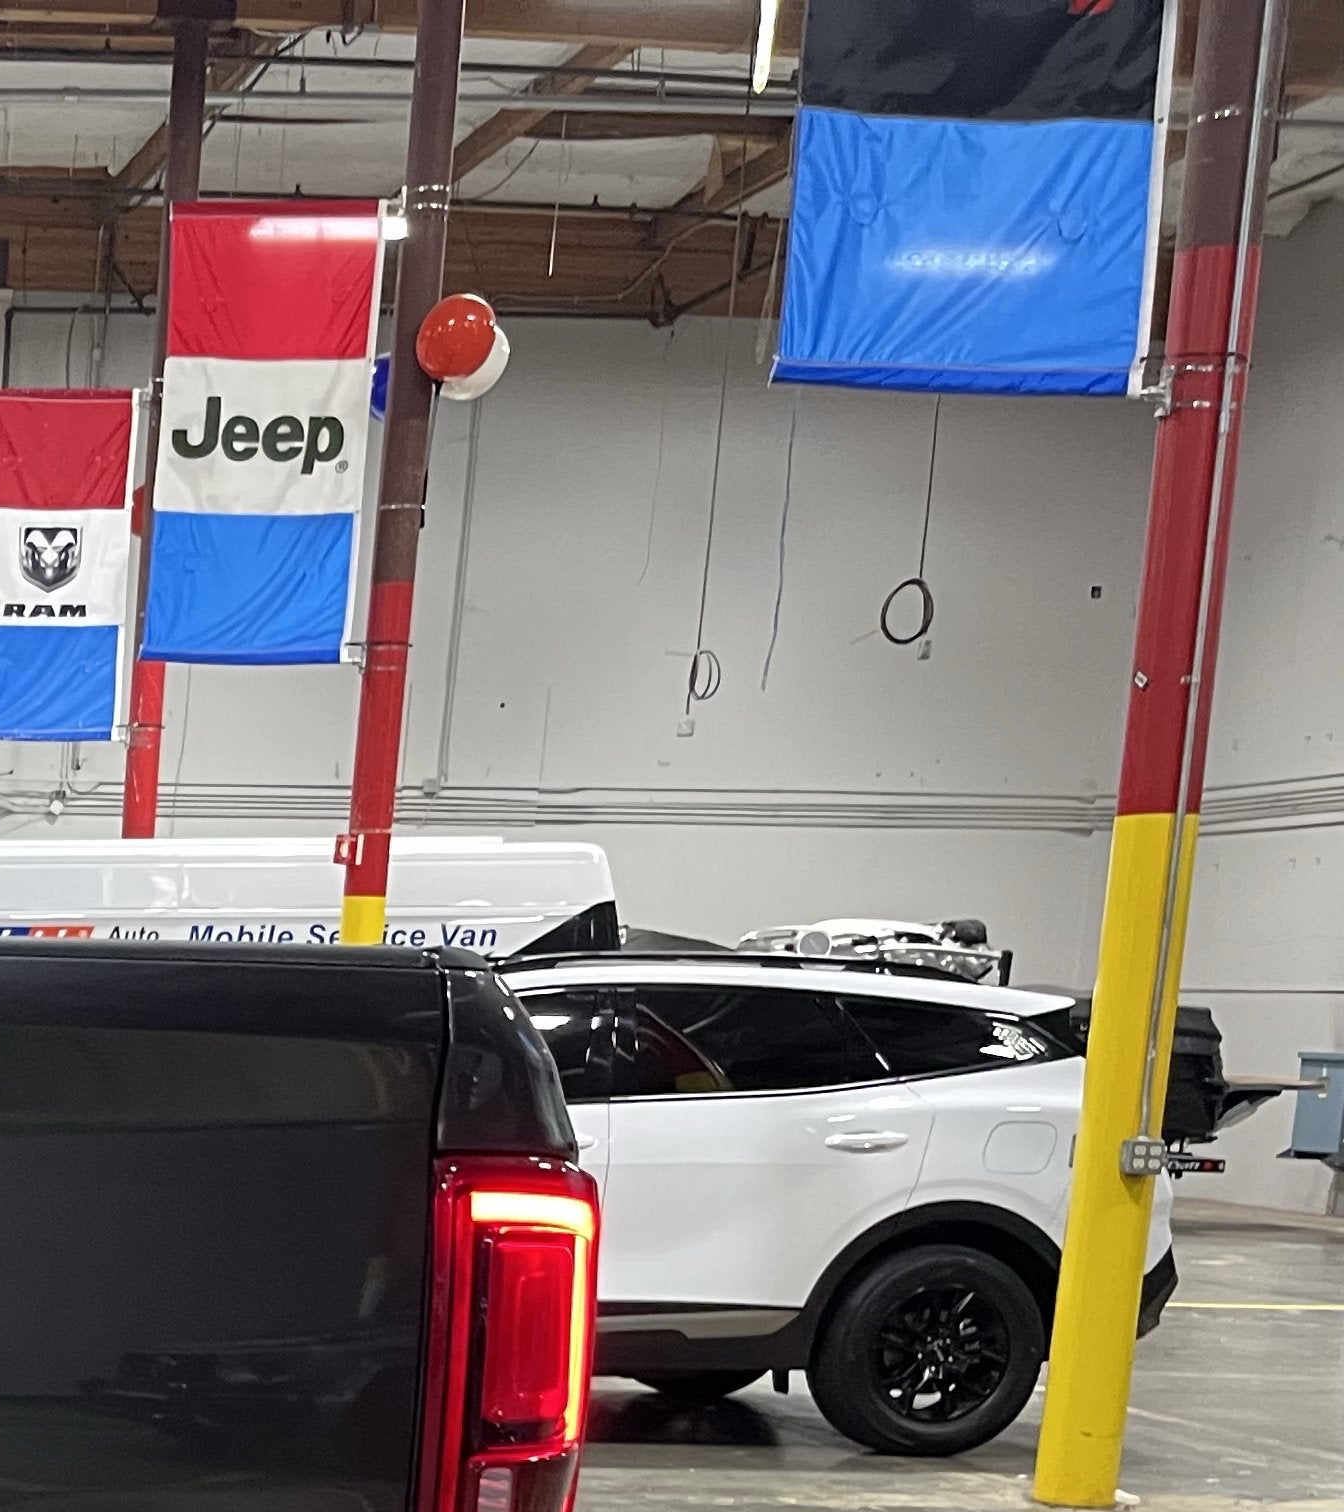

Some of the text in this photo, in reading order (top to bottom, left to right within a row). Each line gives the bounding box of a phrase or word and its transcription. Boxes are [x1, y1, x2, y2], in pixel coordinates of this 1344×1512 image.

[171, 396, 345, 475] Jeep
[3, 603, 87, 618] RAM
[188, 923, 497, 947] Mobile Seice Van
